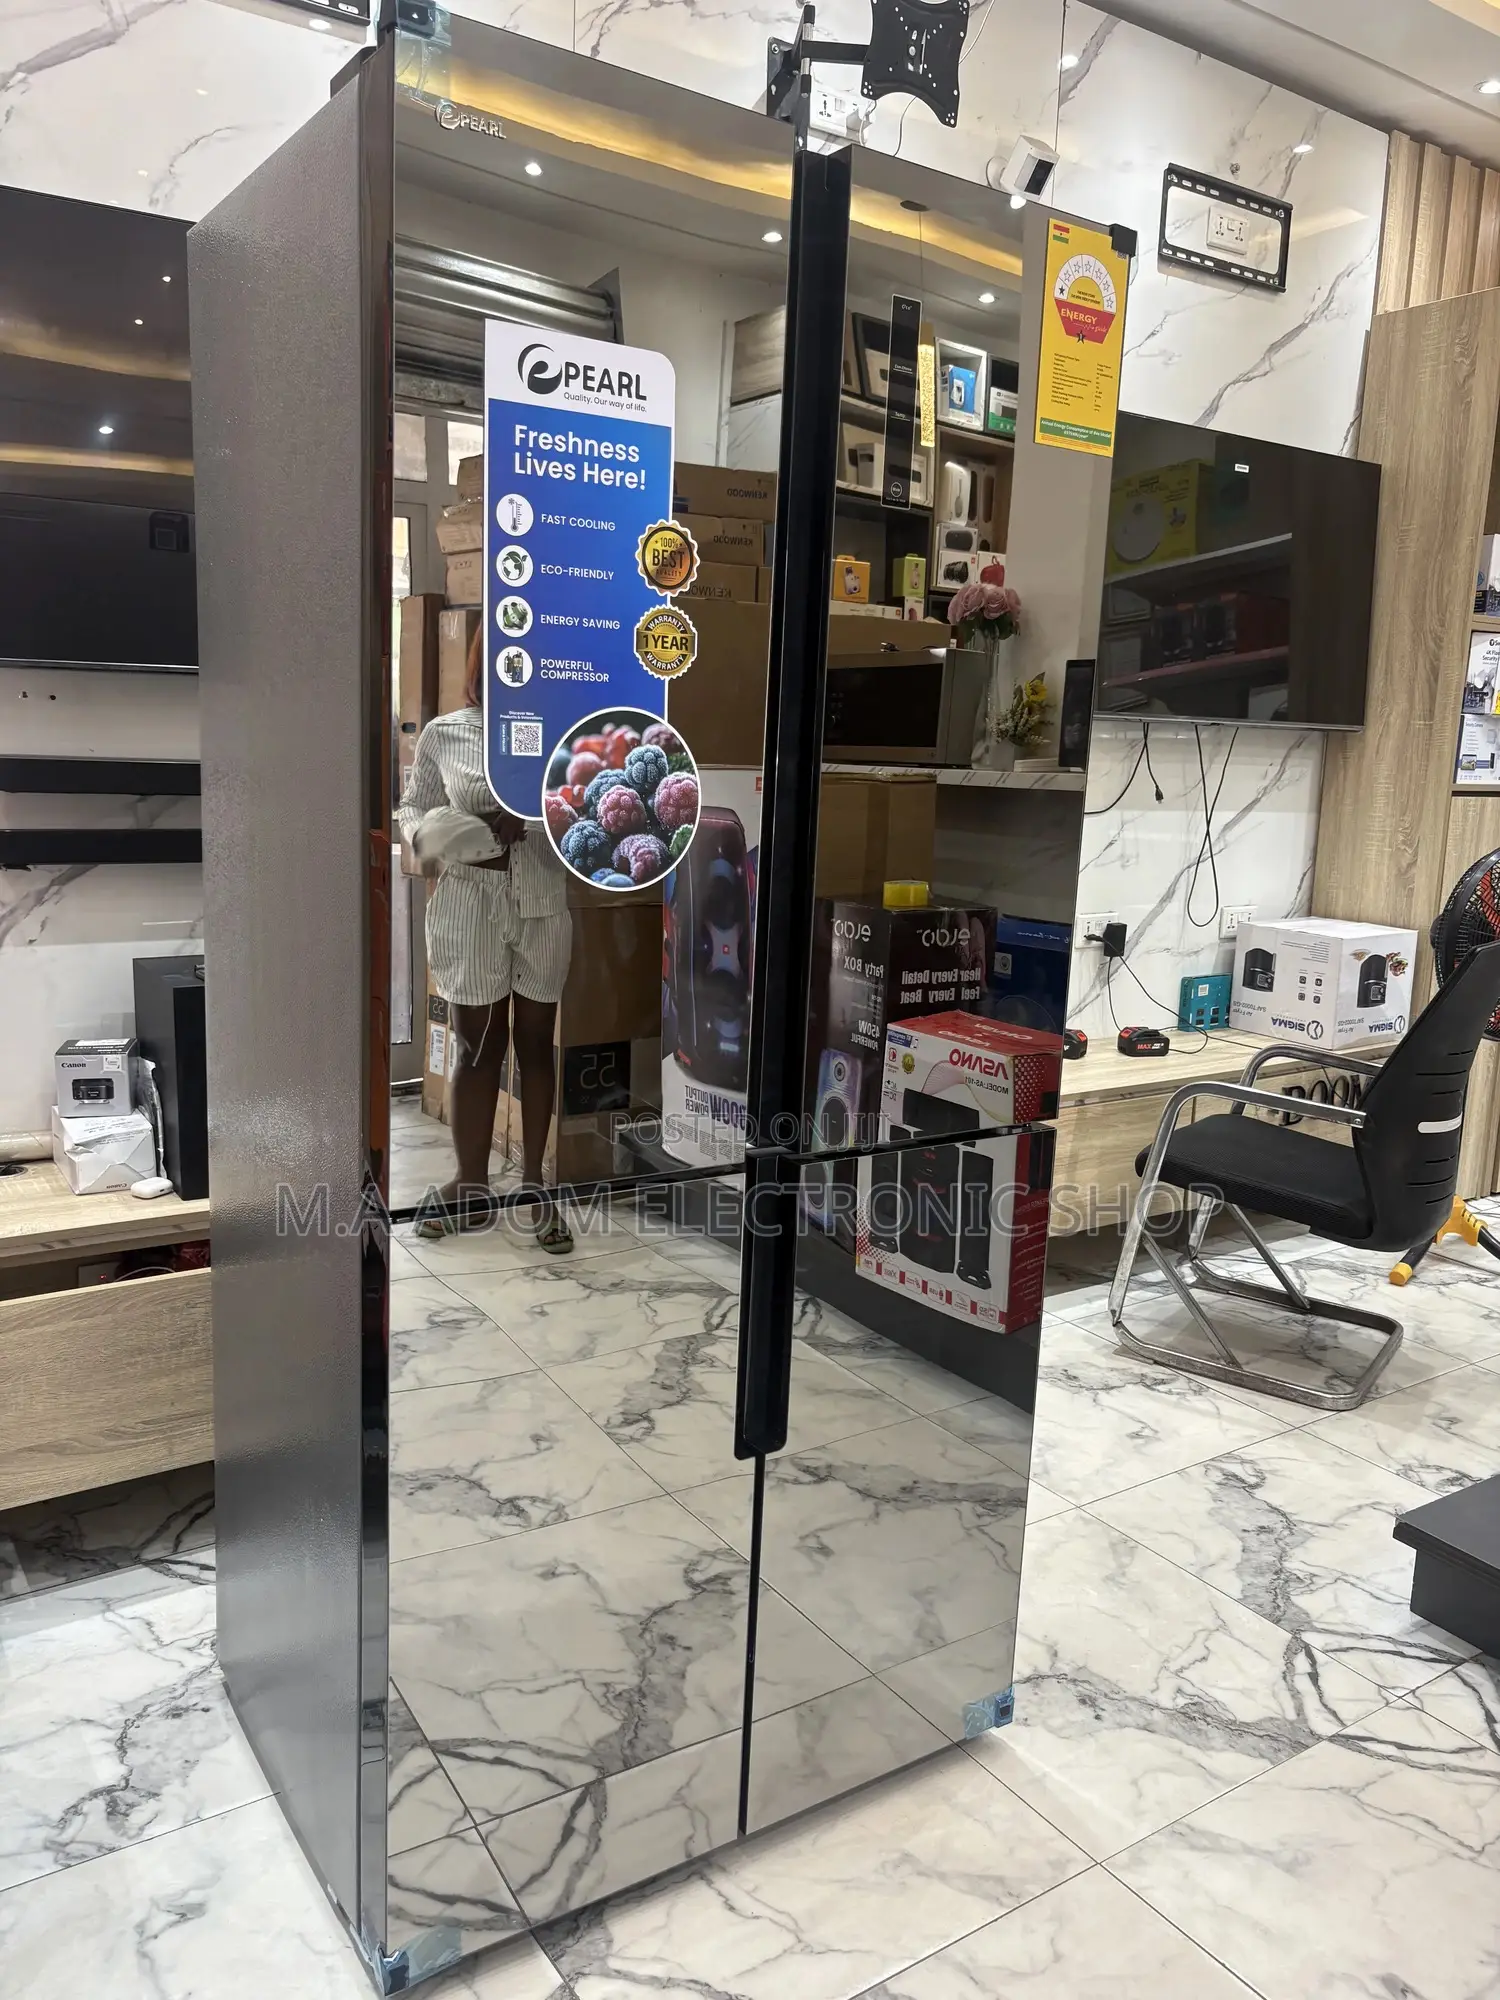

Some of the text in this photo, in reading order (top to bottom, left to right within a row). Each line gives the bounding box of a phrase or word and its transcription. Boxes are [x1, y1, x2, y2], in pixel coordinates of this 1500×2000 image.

[460, 112, 507, 139] PEARL
[1061, 308, 1098, 324] ENERGY
[564, 361, 647, 401] PEARL
[563, 391, 593, 404] Quality.
[594, 396, 608, 405] Our
[608, 400, 625, 410] way
[626, 401, 634, 410] of
[515, 424, 640, 463] Freshness
[515, 452, 646, 490] Lives Here!
[541, 513, 616, 531] FAST COOLING
[660, 536, 679, 548] 100%
[652, 549, 685, 570] BEST
[541, 564, 614, 581] ECO-FRIENDLY
[540, 614, 621, 630] ENERGY SAVING
[648, 615, 685, 633] WARRANTY
[643, 635, 689, 651] 1 YEAR
[541, 658, 594, 671] POWERFUL
[646, 652, 684, 671] WARRANTY
[541, 669, 610, 683] COMPRESSOR
[1271, 1016, 1305, 1032] SIGMA
[1368, 1021, 1393, 1034] SIGMA
